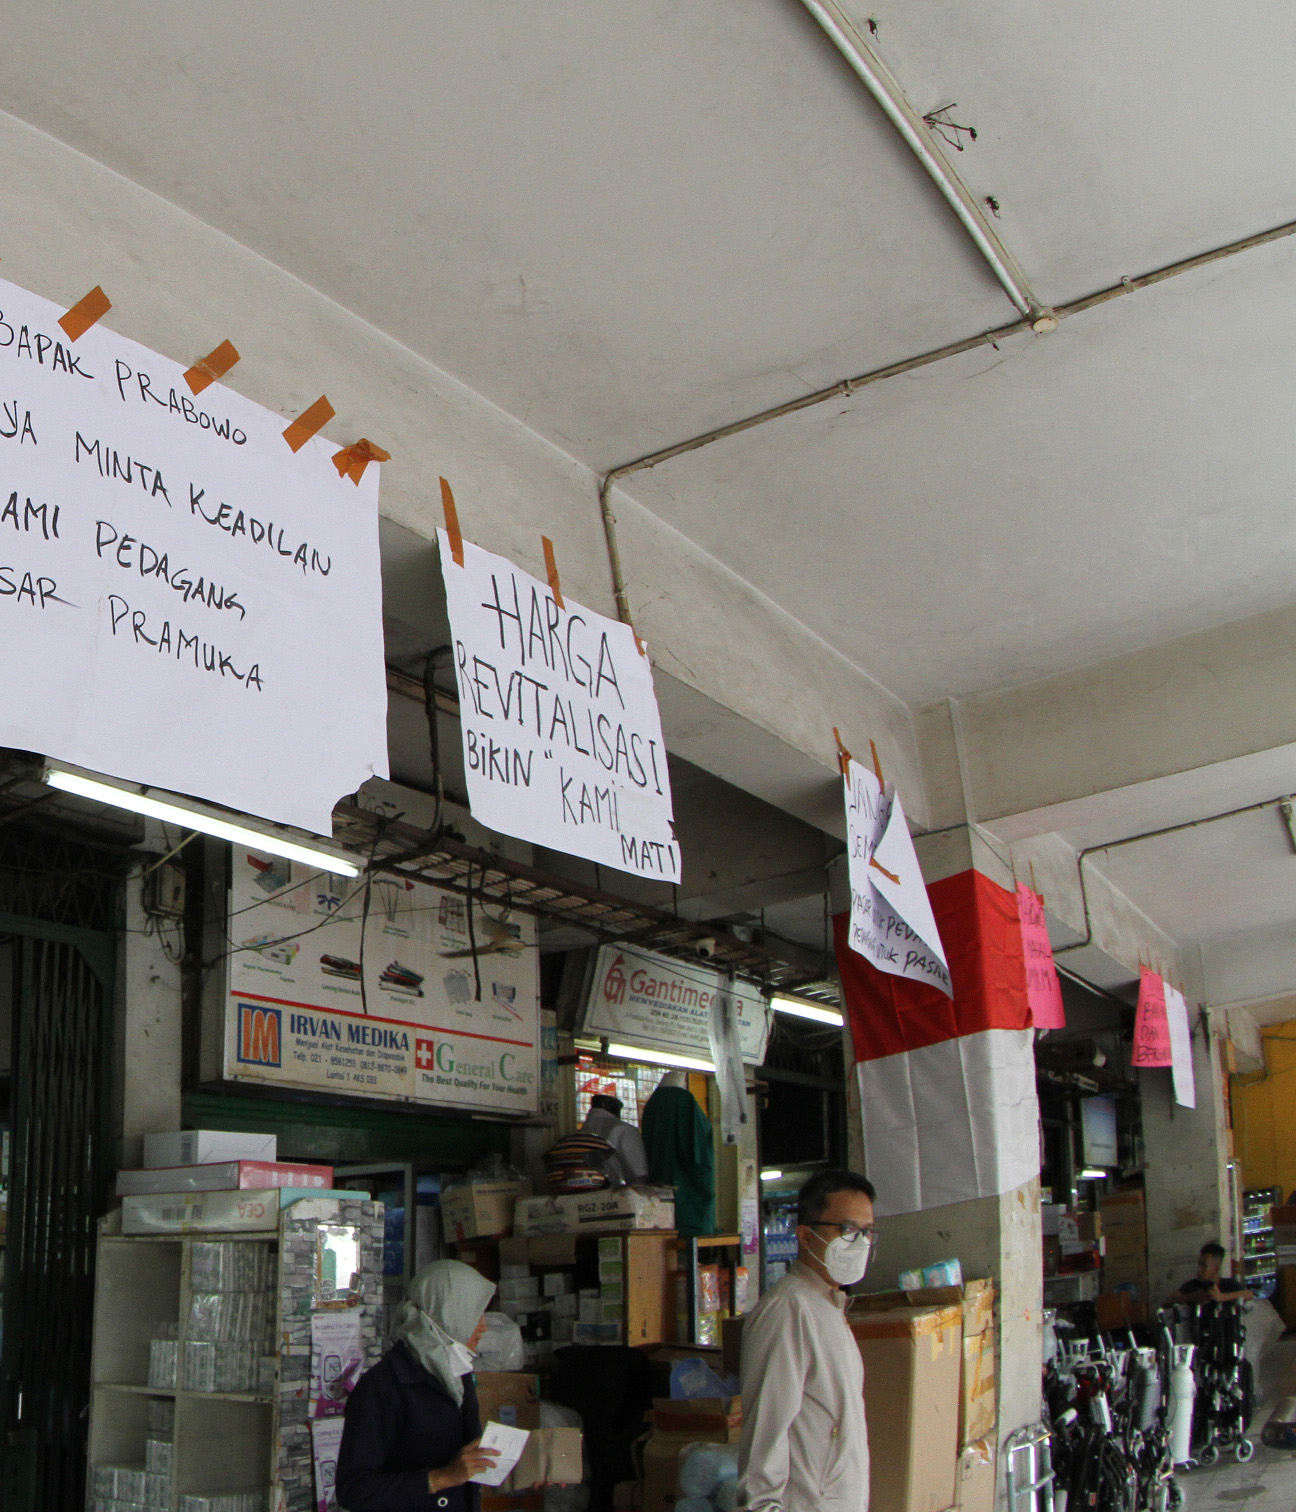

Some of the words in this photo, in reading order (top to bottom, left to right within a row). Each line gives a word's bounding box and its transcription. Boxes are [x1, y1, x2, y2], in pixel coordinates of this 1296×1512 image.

[115, 359, 248, 446] PRABOWO
[75, 431, 172, 508] MINTA
[189, 481, 332, 576] KEADILAN
[95, 520, 246, 620] PEDAGANG
[109, 595, 264, 692] PRAMUKA
[481, 573, 625, 710] HARGA
[456, 640, 663, 796] REVITALISASI
[621, 834, 677, 875] MATI
[290, 1013, 341, 1041] IRVAN
[347, 1023, 410, 1052] MEDIKA
[436, 1042, 495, 1080] General
[499, 1052, 534, 1084] Care
[422, 1073, 434, 1084] The
[437, 1075, 452, 1086] Best
[455, 1078, 477, 1091] Quality
[479, 1081, 490, 1091] For
[492, 1083, 506, 1093] Your
[507, 1085, 528, 1095] Health
